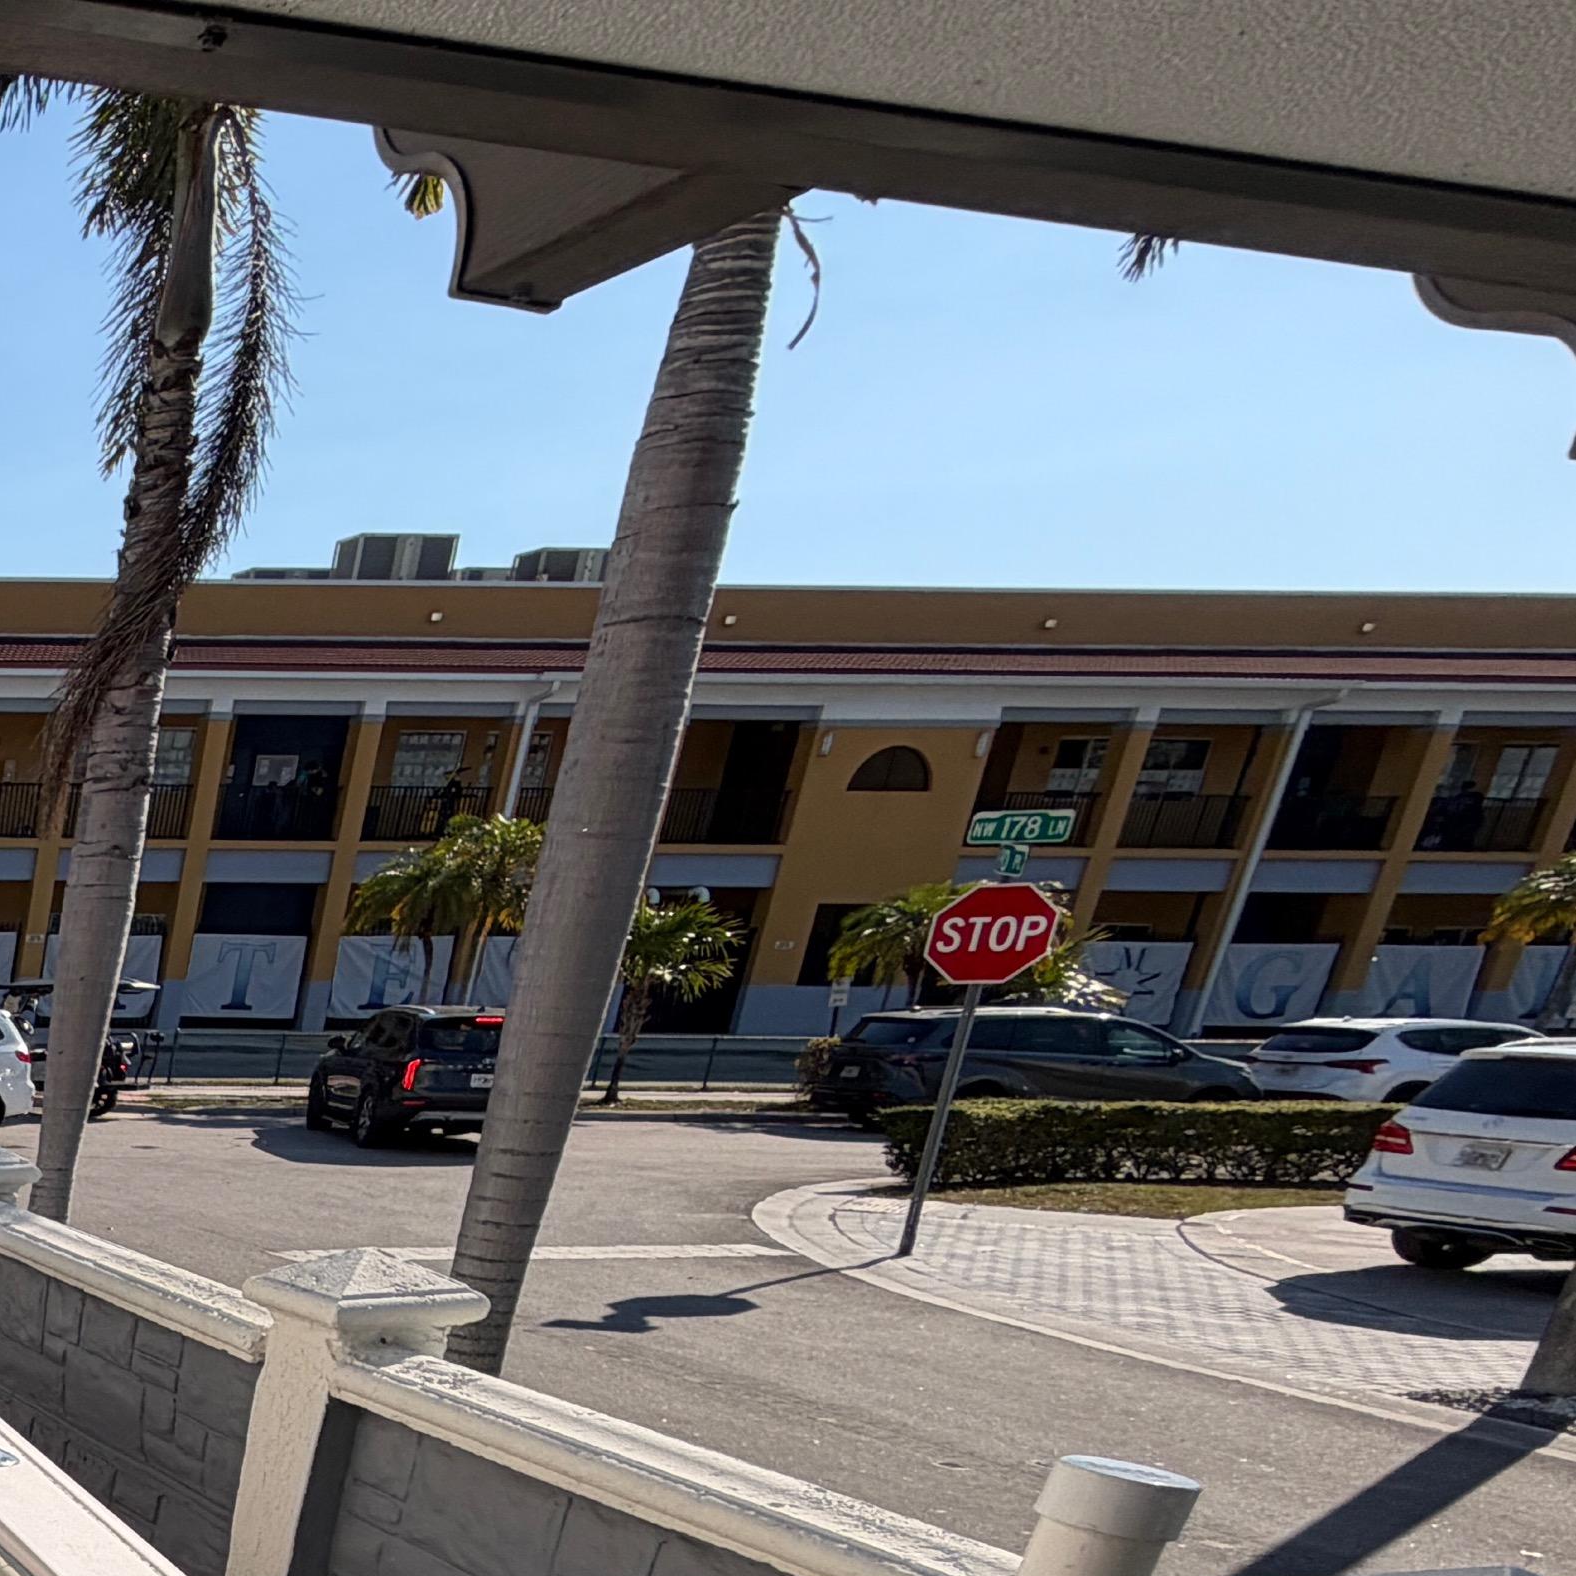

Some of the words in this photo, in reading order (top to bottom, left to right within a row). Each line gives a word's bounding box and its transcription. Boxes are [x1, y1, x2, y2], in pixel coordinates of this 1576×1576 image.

[972, 822, 997, 838] NW
[1000, 815, 1043, 839] 178
[1047, 816, 1069, 836] LN
[935, 914, 1048, 954] STOP
